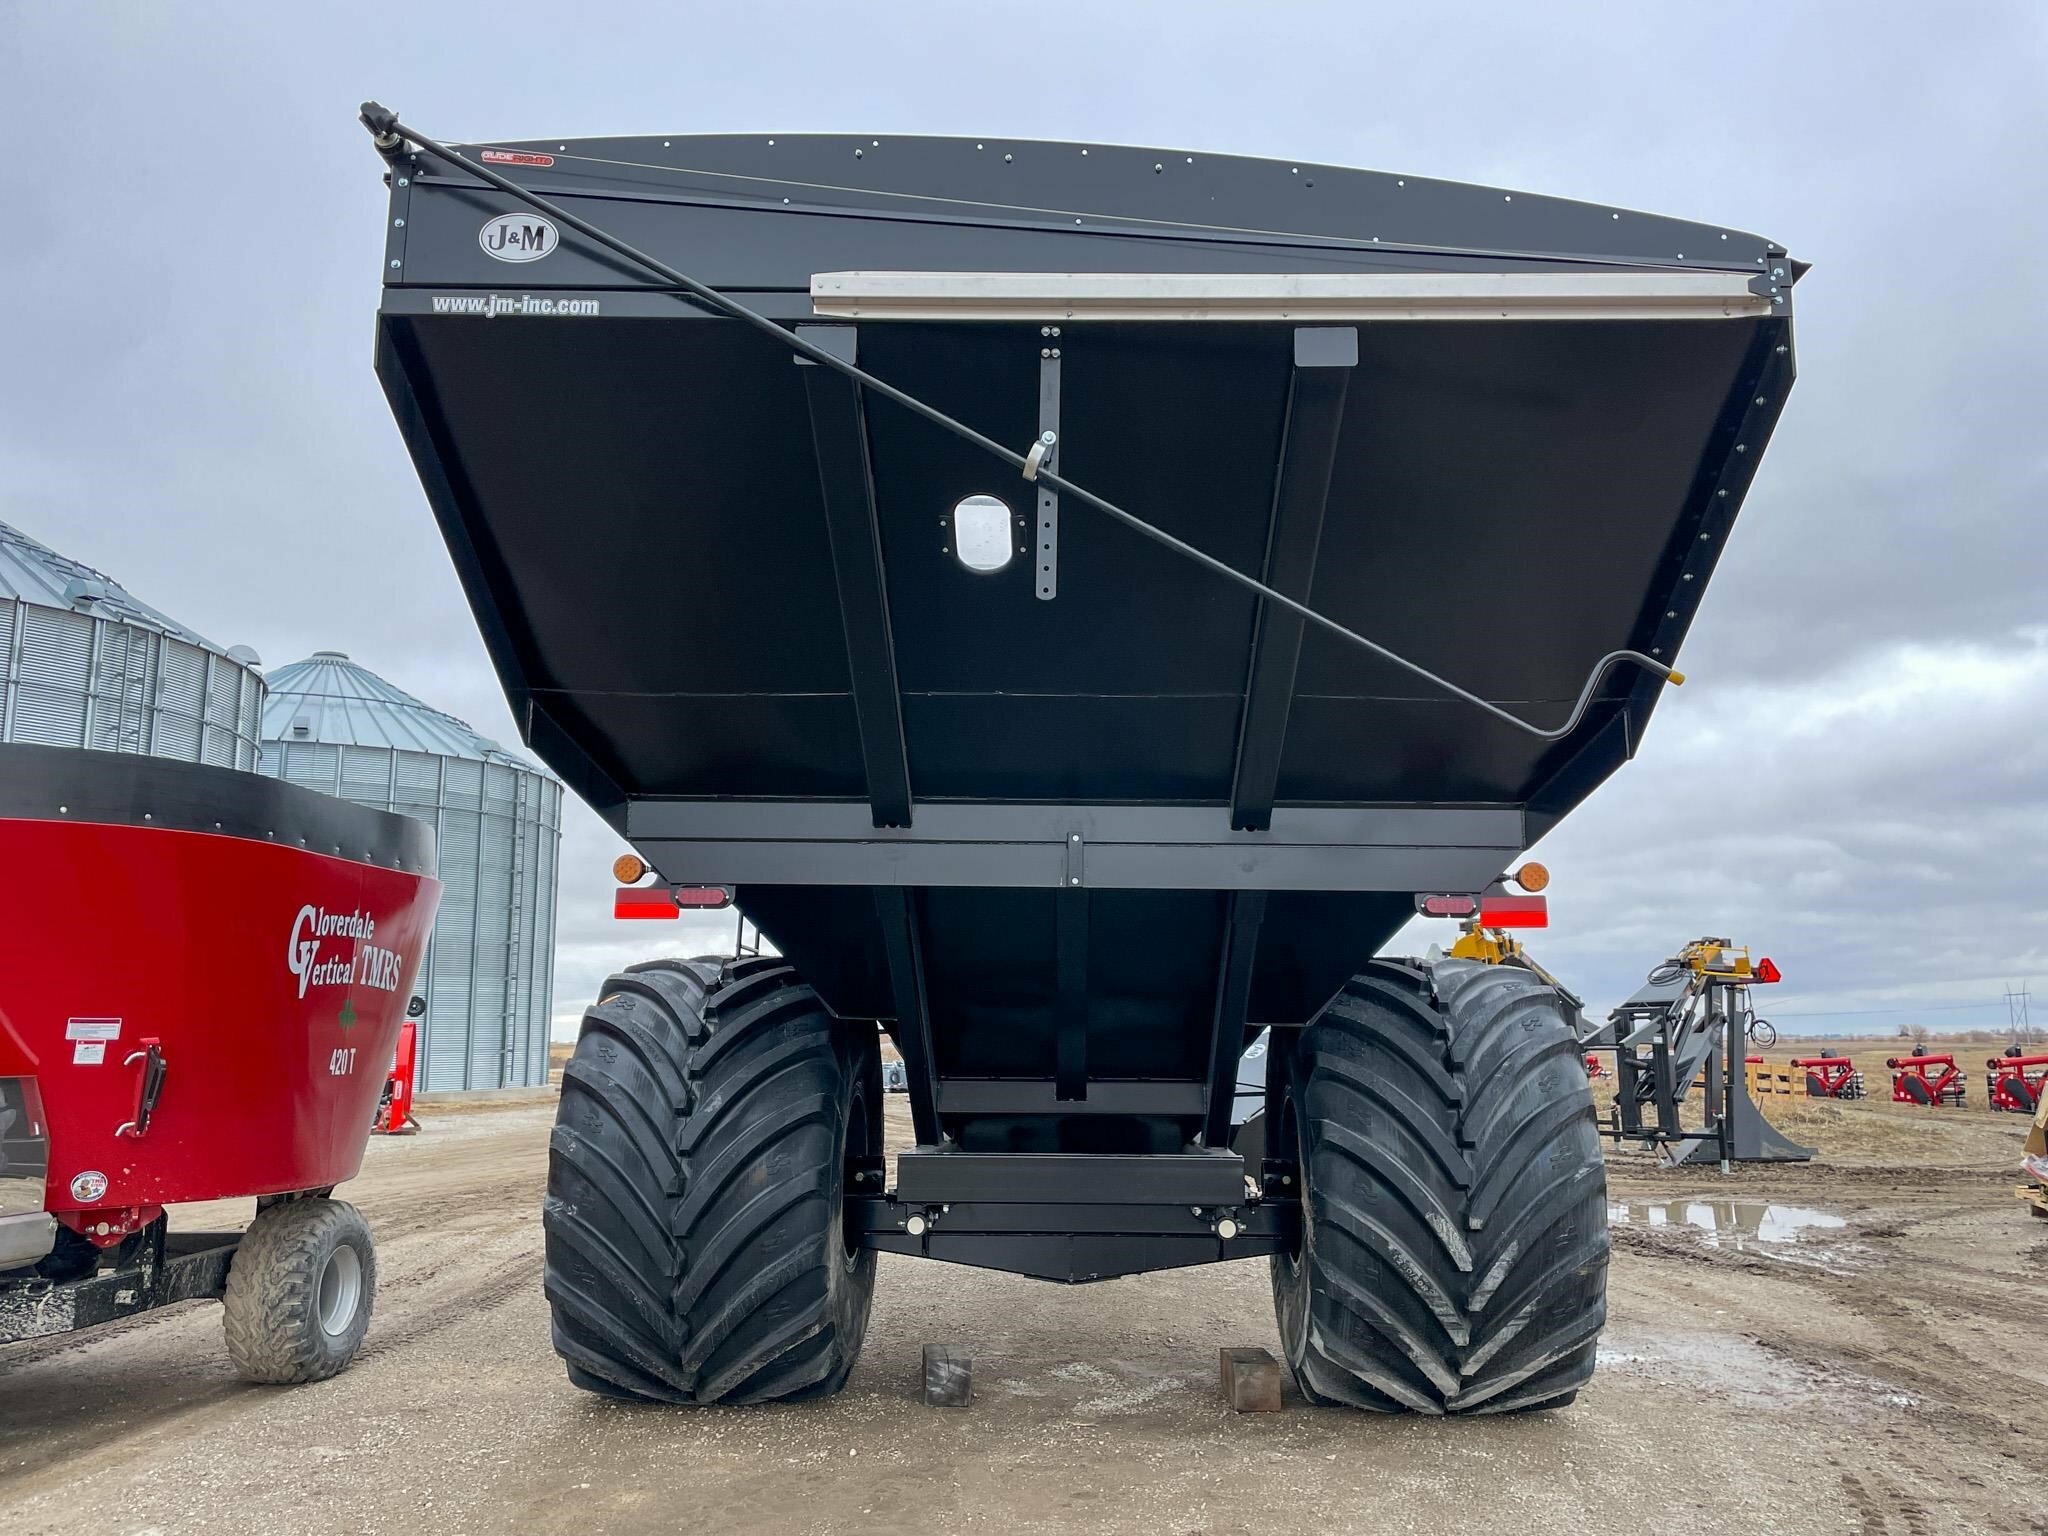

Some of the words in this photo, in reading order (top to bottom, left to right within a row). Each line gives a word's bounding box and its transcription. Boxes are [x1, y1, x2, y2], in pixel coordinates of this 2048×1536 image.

[488, 225, 546, 251] J&M
[432, 294, 599, 318] www.jm-inc.com
[288, 904, 375, 975] Cloverdale
[298, 940, 358, 999] Vertical
[360, 945, 402, 992] TMRS
[329, 1049, 348, 1076] 420
[348, 1048, 356, 1074] T
